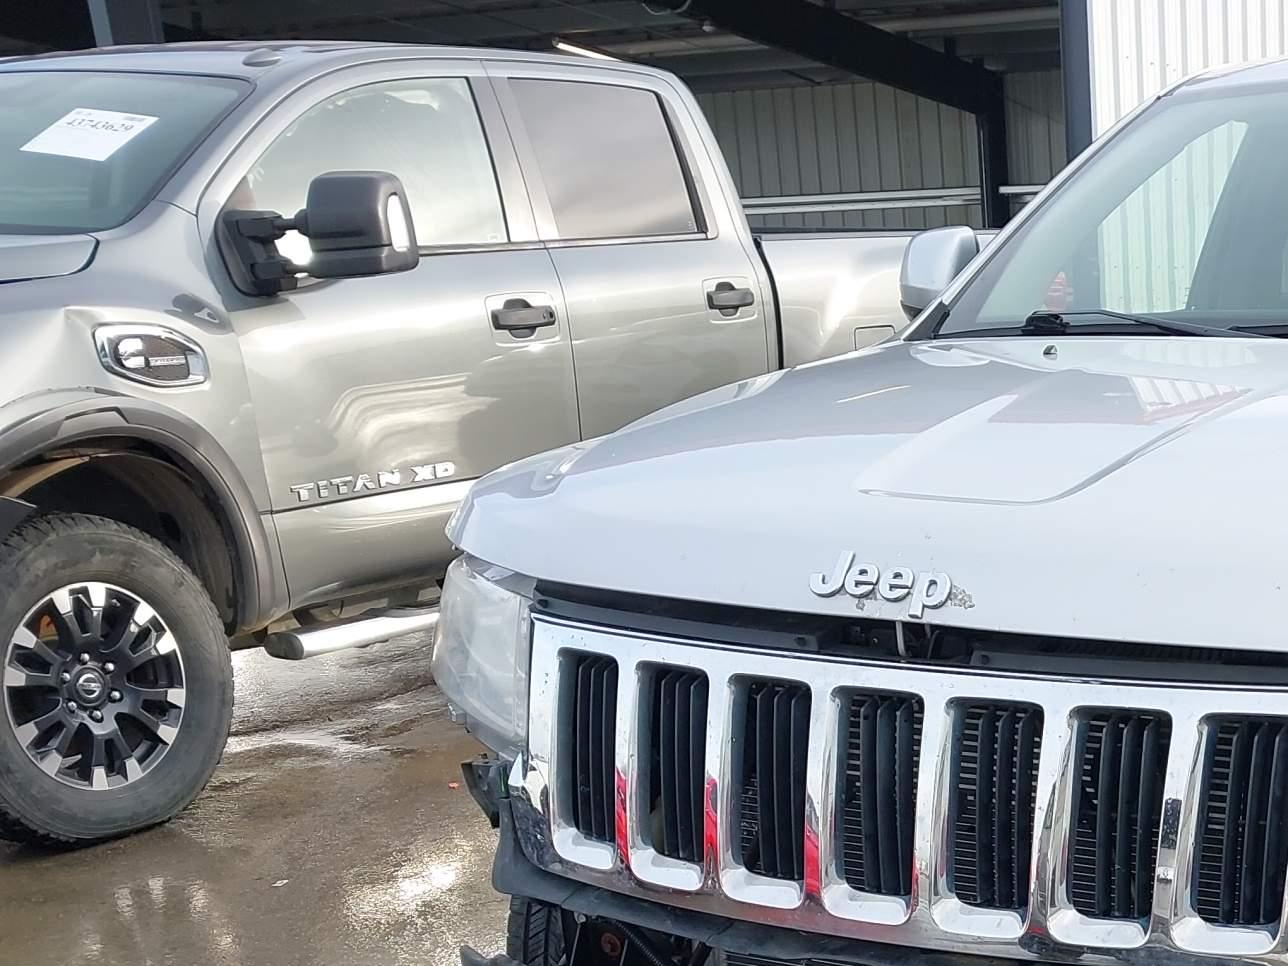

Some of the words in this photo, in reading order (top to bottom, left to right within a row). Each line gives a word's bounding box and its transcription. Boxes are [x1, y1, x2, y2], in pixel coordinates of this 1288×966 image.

[290, 469, 401, 502] TITAN
[410, 461, 455, 482] XD
[809, 549, 953, 619] Jeep
